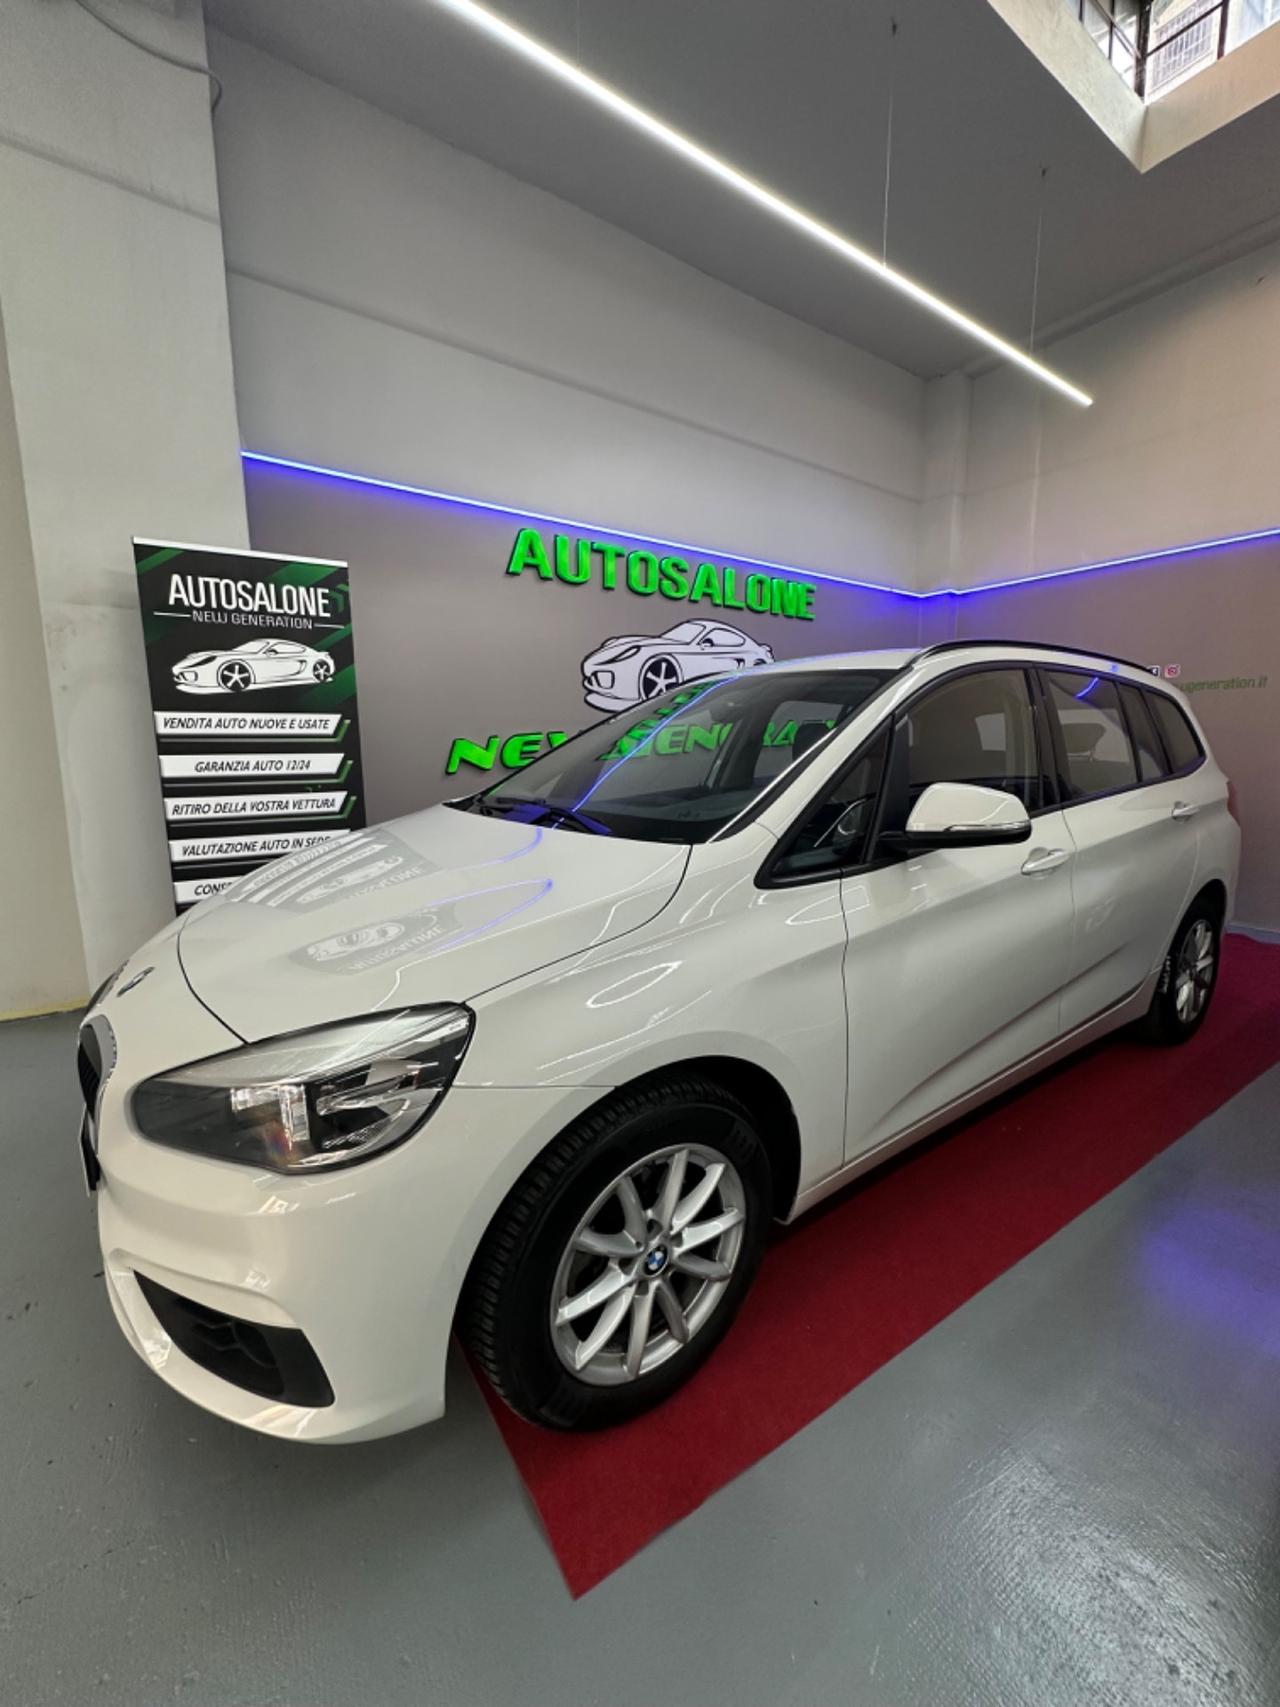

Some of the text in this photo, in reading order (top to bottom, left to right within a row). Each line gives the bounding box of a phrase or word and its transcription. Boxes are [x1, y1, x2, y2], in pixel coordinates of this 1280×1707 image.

[506, 528, 817, 621] AUTOSALONE
[168, 573, 331, 617] AUTOSALONE
[231, 614, 313, 630] GENERATION
[163, 717, 330, 731] VENDITA AUTO NUOVE E USATE
[194, 760, 311, 773] GARANZIA AUTO 12/24
[171, 798, 335, 816] RITIRO DELLA VOSTRA VETTURA
[182, 842, 258, 857] VALUTAZIONE
[260, 839, 290, 851] AUTO
[291, 838, 304, 849] IN
